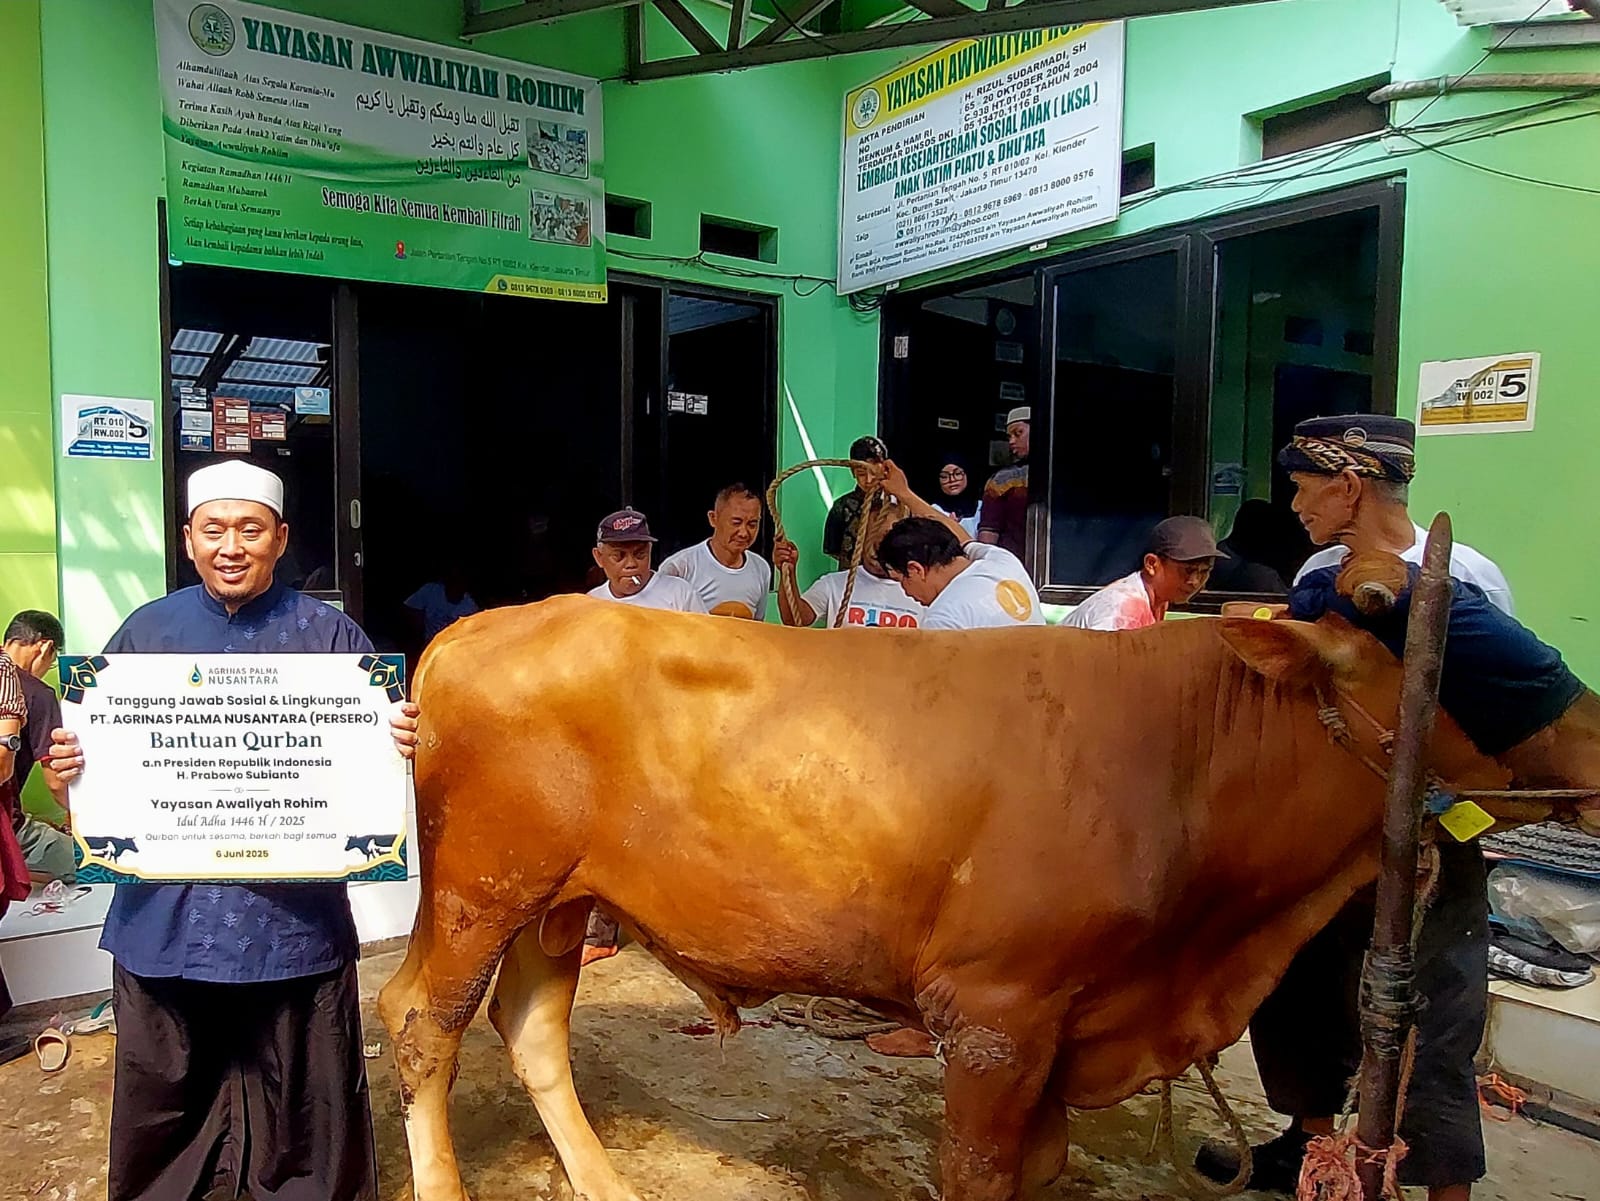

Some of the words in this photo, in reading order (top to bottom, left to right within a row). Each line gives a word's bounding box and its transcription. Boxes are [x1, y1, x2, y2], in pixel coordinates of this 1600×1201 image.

[242, 16, 354, 70] YAYASAN
[360, 41, 499, 99] AWWALIYAH
[505, 73, 584, 116] ROHIIM
[858, 130, 879, 146] AKTA
[881, 110, 924, 136] PENDIRIAN
[965, 90, 973, 101] H.
[976, 76, 1004, 96] RIZUL
[1006, 48, 1069, 84] SUDARMADI,
[1072, 41, 1086, 55] SH
[886, 57, 944, 113] YAYASAN
[355, 85, 381, 115] كريم
[858, 144, 869, 155] NO
[964, 100, 975, 112] 65
[982, 92, 993, 104] 20
[996, 71, 1043, 98] OKTOBER
[1046, 59, 1070, 78] 2004
[178, 98, 207, 112] Terima
[209, 104, 232, 116] Kasih
[234, 108, 254, 122] Ayah
[257, 112, 281, 124] Bunda
[324, 123, 342, 136] Yang
[480, 109, 495, 128] الله
[858, 143, 892, 164] MENKUM
[895, 140, 900, 149] &
[903, 132, 921, 147] HAM
[923, 127, 932, 138] RI
[1034, 71, 1070, 94] TAHUN
[1073, 59, 1098, 78] 2004
[179, 116, 218, 131] Diberikan
[222, 123, 242, 134] Pada
[271, 131, 292, 143] Yatim
[294, 135, 308, 145] dan
[430, 130, 455, 152] بخير
[856, 158, 898, 193] LEMBAGA
[900, 128, 977, 176] KESEJAHTERAAN
[979, 112, 1017, 147] SOSIAL
[1019, 99, 1050, 131] ANAK
[1061, 83, 1090, 116] LKSA
[857, 148, 903, 173] TERDAFTAR
[905, 135, 935, 155] DINSOS
[938, 128, 953, 141] DKI
[964, 119, 974, 131] 05
[1033, 94, 1039, 104] B
[506, 139, 520, 162] كل
[181, 160, 216, 175] Kegiatan
[218, 165, 261, 180] Ramadhan
[893, 173, 920, 199] ANAK
[921, 161, 952, 189] YATIM
[954, 149, 984, 178] PIATU
[987, 148, 995, 166] &
[998, 126, 1045, 162] DHU'AFA
[182, 177, 224, 192] Ramadhan
[856, 203, 890, 223] Sekretariat
[906, 188, 938, 206] Pertanian
[941, 177, 966, 194] Tengah
[968, 173, 980, 184] No.
[982, 170, 987, 179] 5
[991, 165, 1002, 176] RT
[1052, 136, 1086, 155] Klender
[912, 200, 932, 214] Duren
[960, 181, 987, 198] Jakarta
[989, 173, 1012, 188] Timur
[1014, 164, 1037, 180] 13470
[1050, 175, 1070, 189] 8000
[182, 195, 211, 207] Berkah
[214, 199, 238, 211] Untuk
[321, 187, 370, 214] Semoga
[374, 194, 397, 215] Kita
[401, 198, 438, 221] Semua
[441, 203, 488, 227] Kembali
[491, 210, 520, 232] Fitrah
[1499, 373, 1526, 397] 5
[94, 418, 106, 426] RT.
[108, 418, 124, 427] 010
[128, 420, 148, 438] 5
[94, 428, 124, 438] RW.002
[209, 676, 278, 685] NUSANTARA
[107, 696, 176, 709] Tanggung
[179, 696, 224, 705] Jawab
[227, 694, 266, 705] Sosial
[269, 696, 279, 705] &
[282, 694, 360, 708] Lingkungan
[90, 714, 110, 724] PT.
[113, 714, 173, 724] AGRINAS
[176, 714, 222, 724] PALMA
[225, 714, 307, 724] NUSANTARA
[310, 711, 378, 726] (PERSERO)
[151, 732, 236, 748] Bantuan
[243, 731, 322, 751] Qurban
[164, 758, 216, 767] Presiden
[219, 757, 271, 771] Republik
[273, 757, 331, 767] Indonesia
[177, 771, 188, 779] H.
[191, 771, 243, 779] Prabowo
[246, 770, 299, 779] Subianto
[151, 800, 212, 812] Yayasan
[216, 798, 280, 812] Awaliyah
[284, 797, 328, 808] Rohim
[177, 815, 199, 826] Idul
[201, 815, 226, 826] Adha
[231, 817, 254, 826] 1446
[258, 814, 268, 826] H
[280, 816, 305, 825] 2025
[284, 832, 304, 841] bagi
